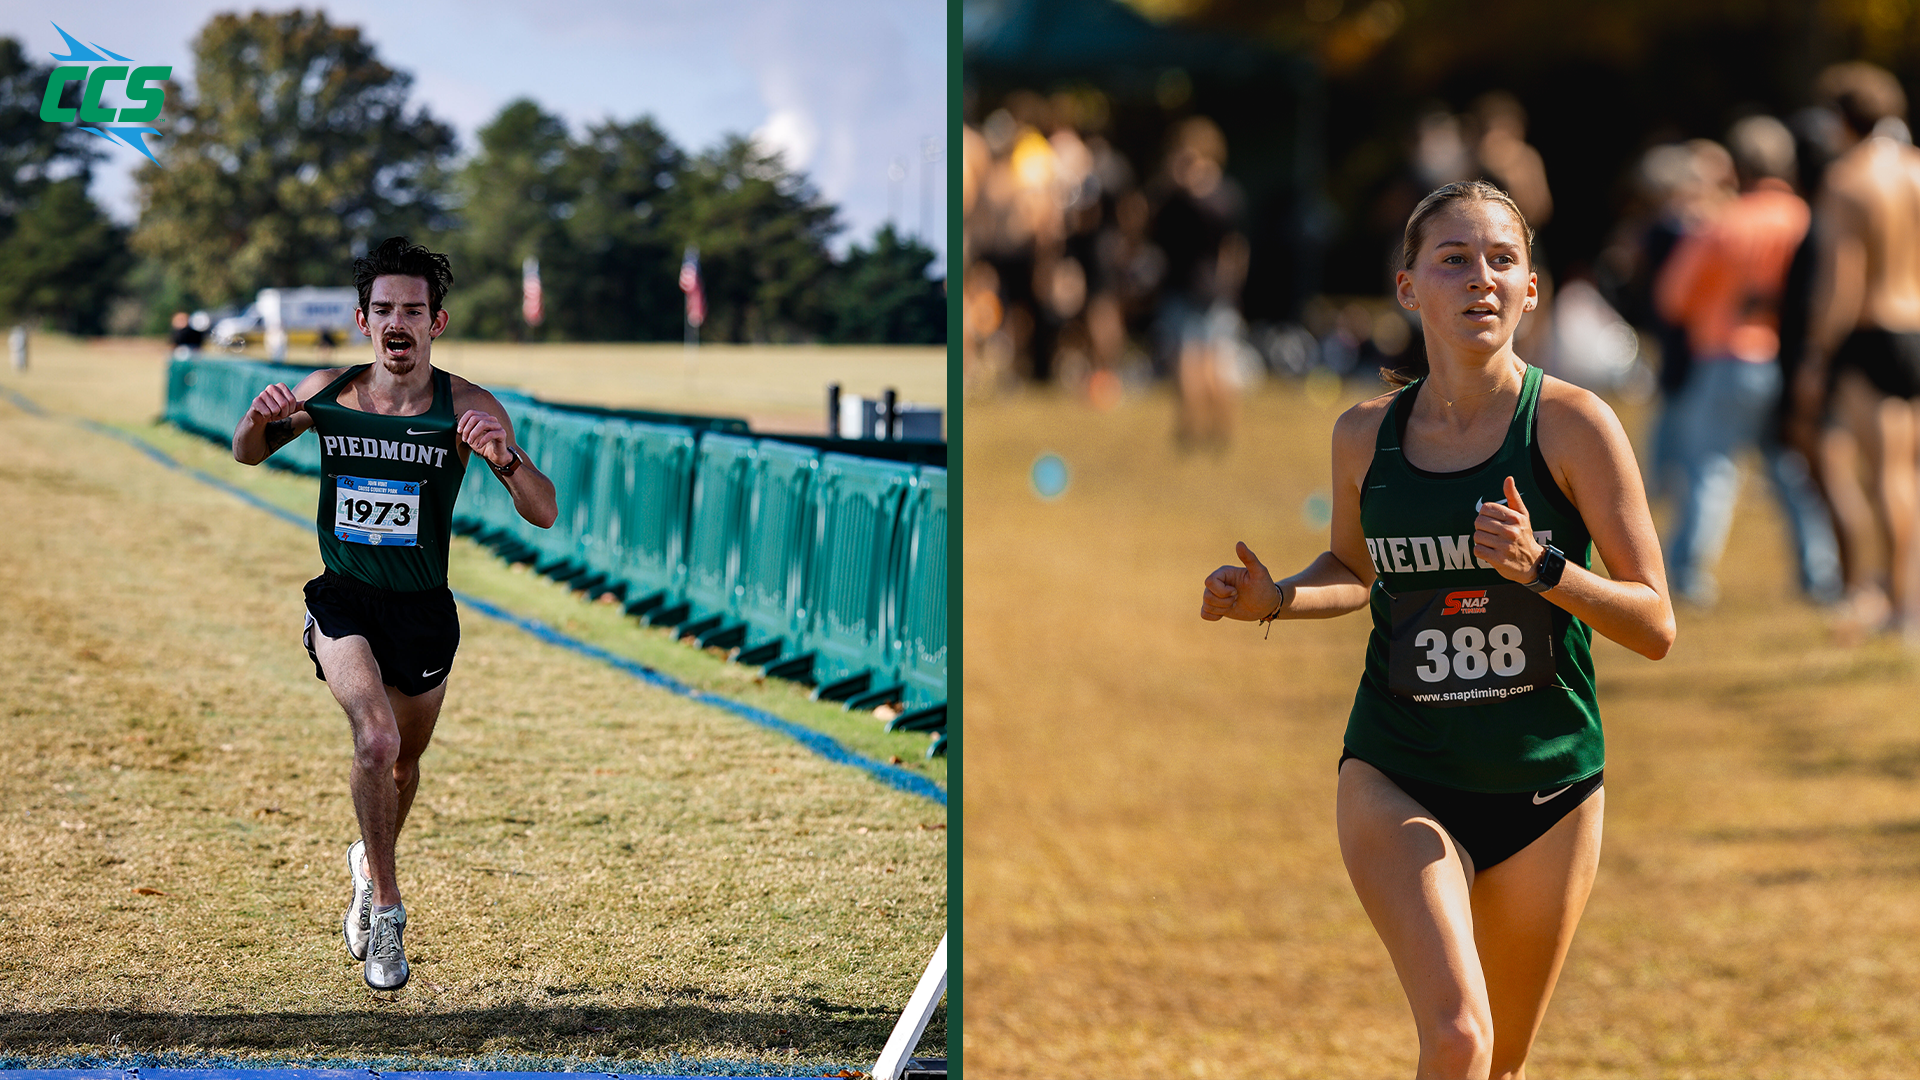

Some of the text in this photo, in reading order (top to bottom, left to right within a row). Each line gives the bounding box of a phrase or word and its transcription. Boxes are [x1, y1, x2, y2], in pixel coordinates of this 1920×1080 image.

[323, 435, 448, 468] PIEDMONT
[344, 498, 410, 526] 1973
[1366, 530, 1552, 573] PIEDMT
[1441, 590, 1489, 616] SNAP
[1415, 624, 1526, 683] 388
[1413, 683, 1534, 702] www.snaptiming.com
